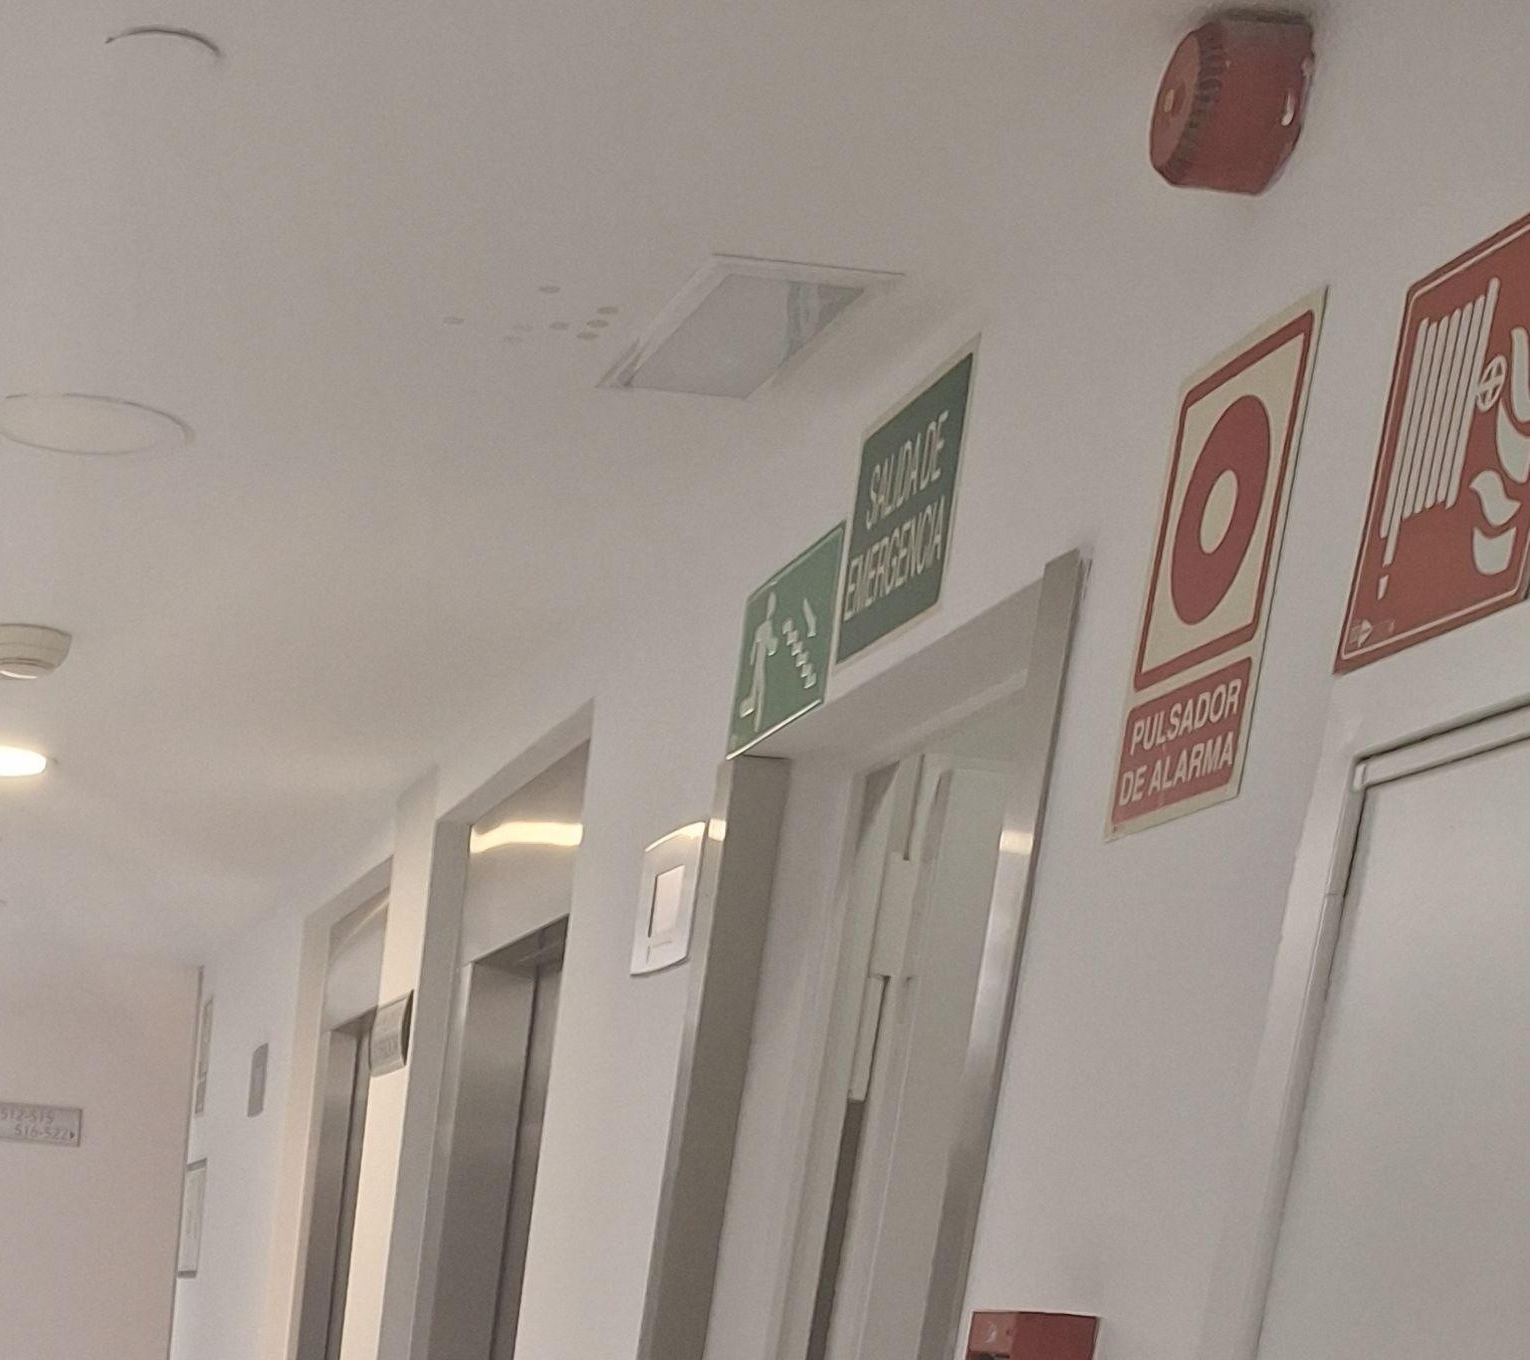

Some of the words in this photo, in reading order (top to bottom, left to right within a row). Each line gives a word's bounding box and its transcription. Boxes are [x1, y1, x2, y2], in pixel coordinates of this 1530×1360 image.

[866, 431, 920, 529] SALIDA
[920, 410, 949, 490] DE
[844, 495, 945, 621] EMERGENCIA
[1130, 678, 1242, 756] PULSADOR
[1119, 765, 1147, 806] DE
[1148, 731, 1234, 798] ALARMA
